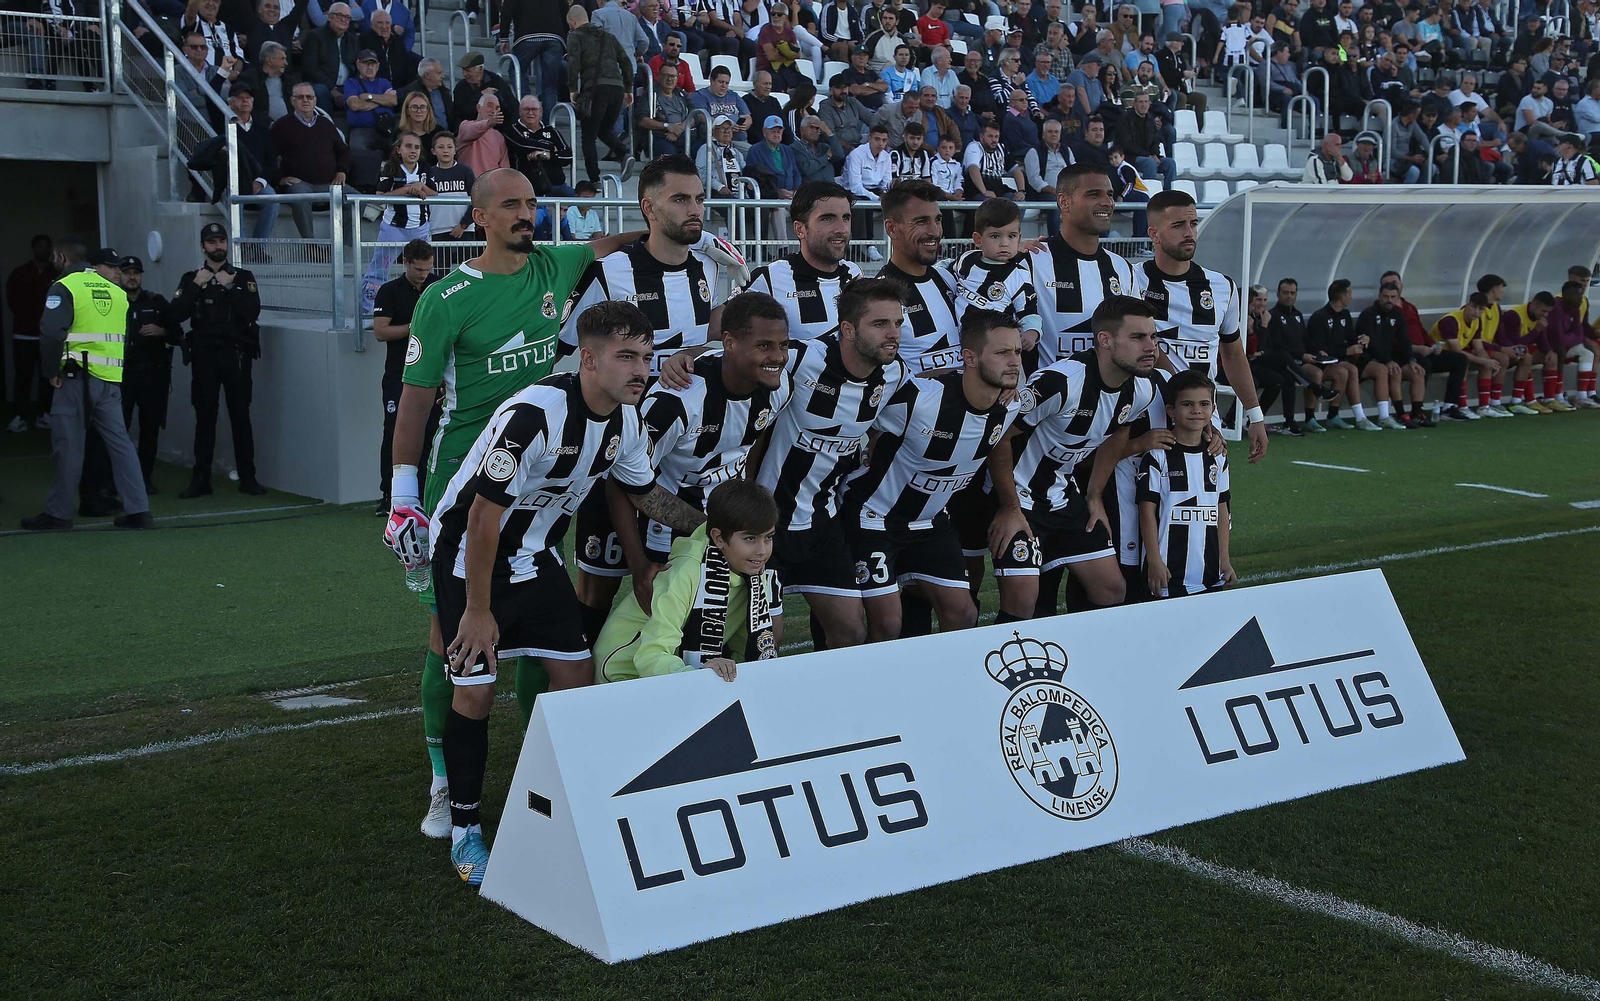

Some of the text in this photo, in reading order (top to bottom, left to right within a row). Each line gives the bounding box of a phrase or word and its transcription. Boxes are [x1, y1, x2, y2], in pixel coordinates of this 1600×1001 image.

[440, 279, 471, 300] LEGEA
[487, 340, 556, 375] LOTUS
[1157, 341, 1209, 360] OTUS
[1171, 509, 1217, 522] LOTUS
[604, 531, 622, 565] 6
[870, 551, 889, 584] 3
[1004, 688, 1109, 772] REAL BALOMPEDICA
[1184, 671, 1405, 765] LOTUS
[1051, 785, 1109, 815] LINENSE
[616, 761, 929, 892] LOTUS
